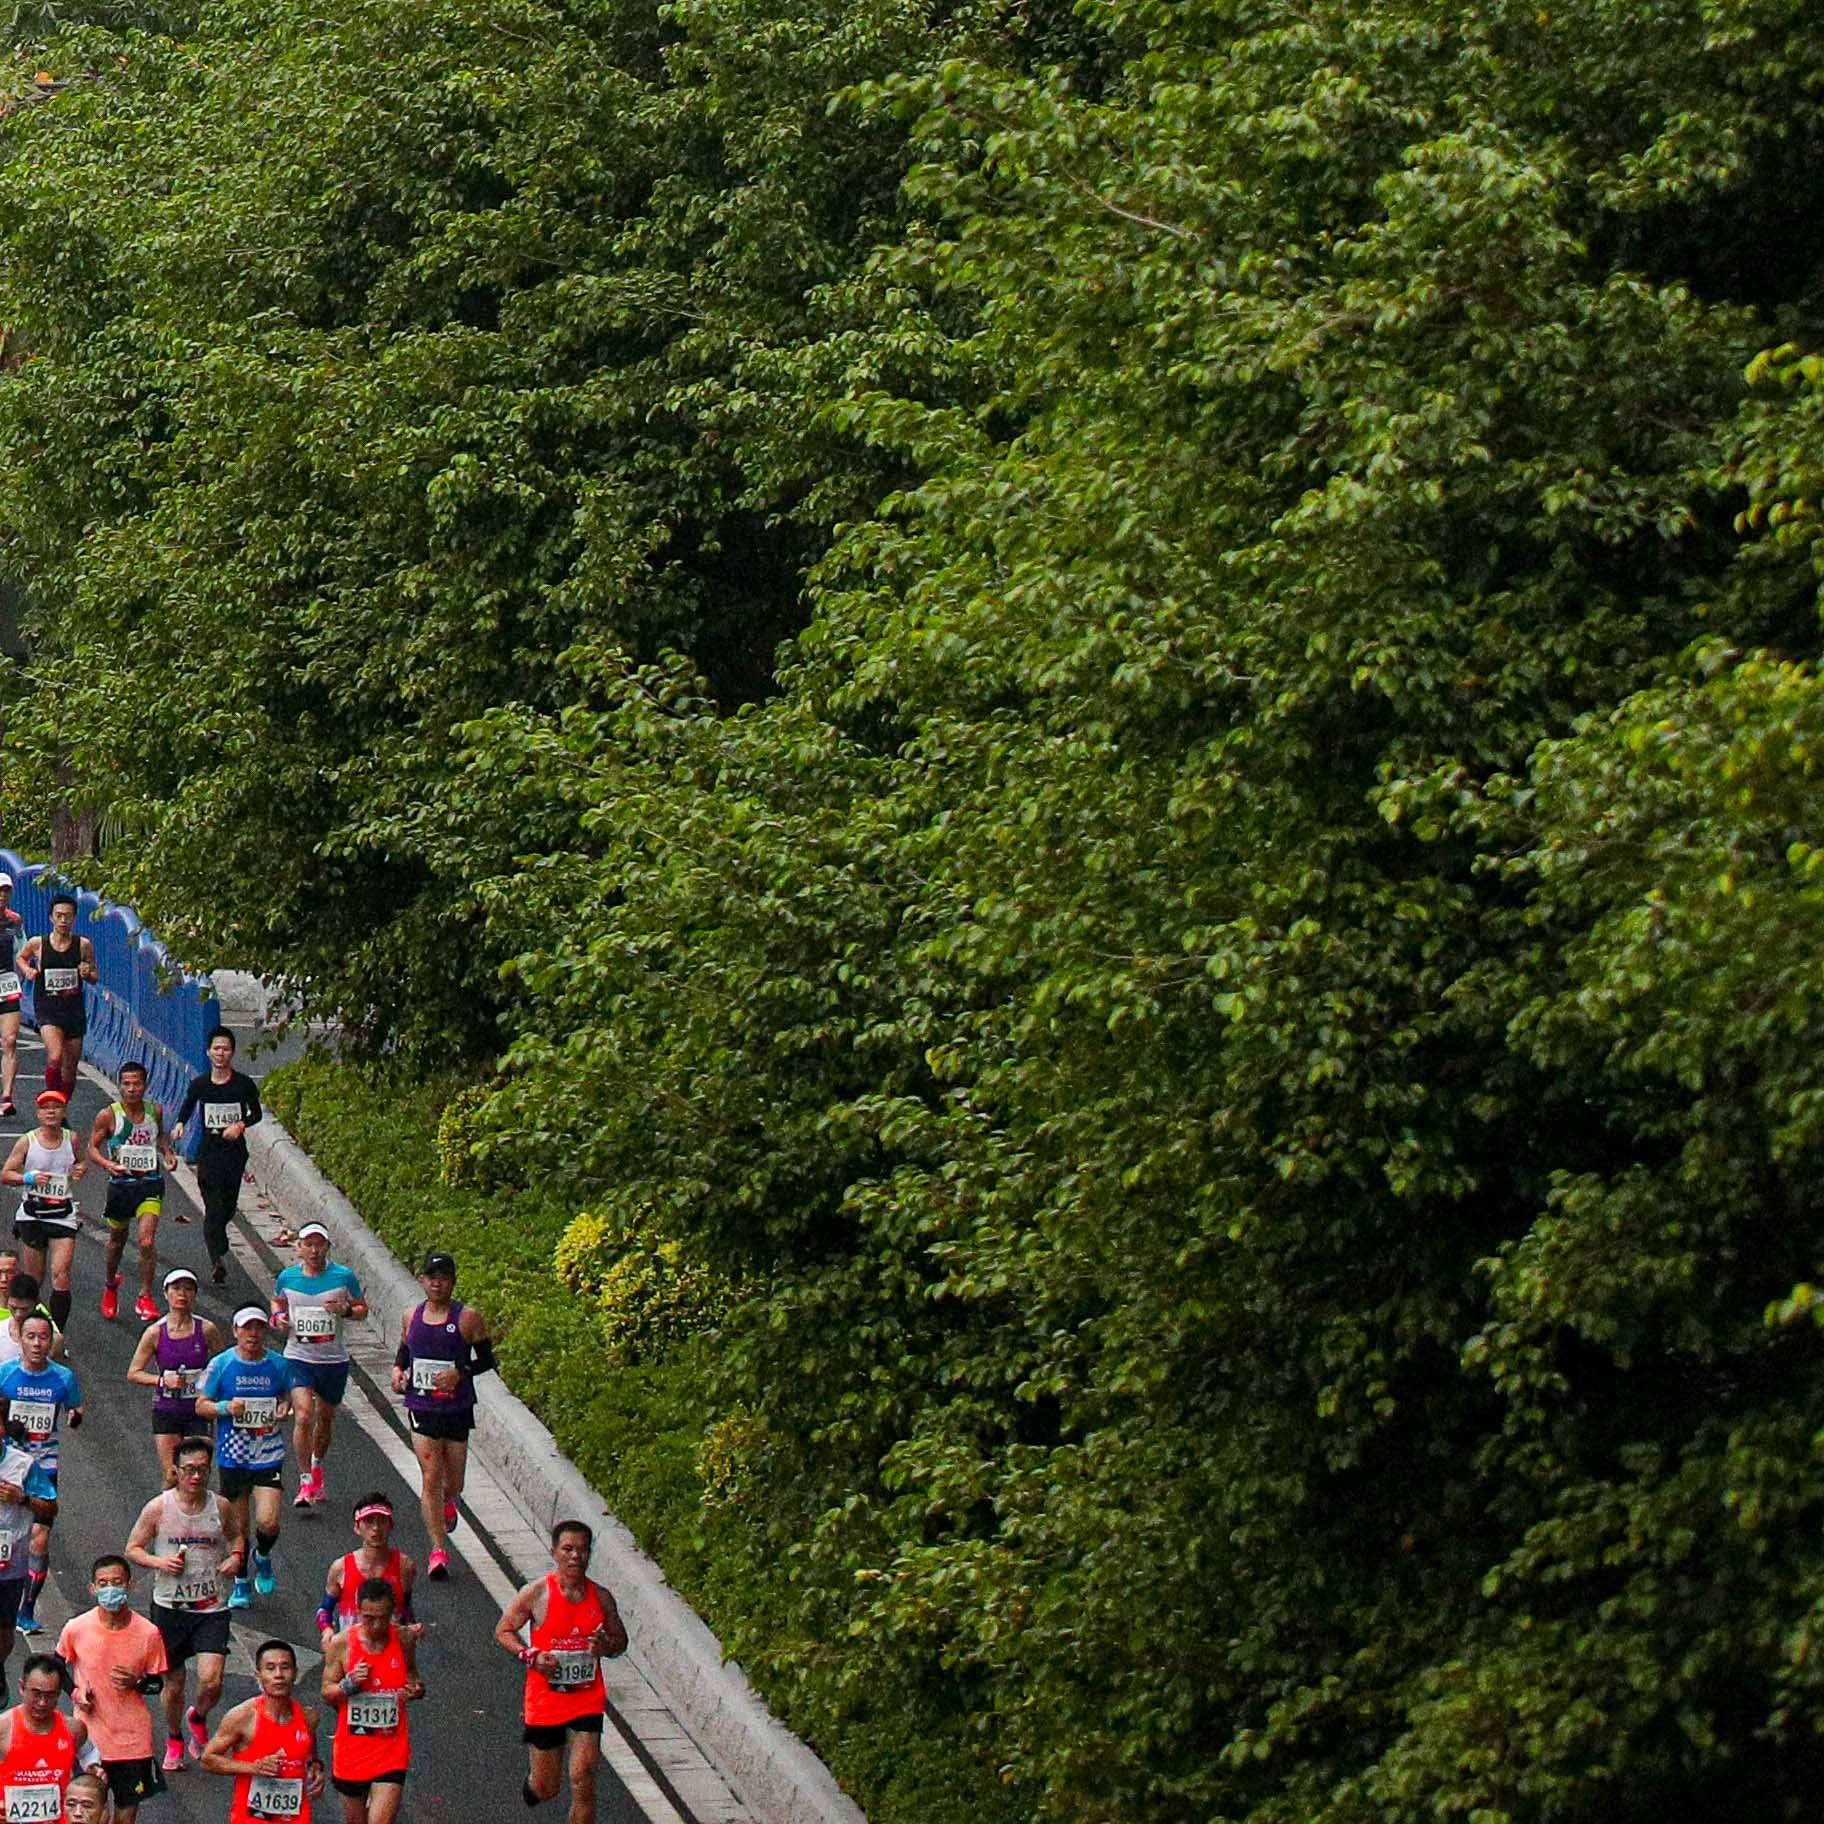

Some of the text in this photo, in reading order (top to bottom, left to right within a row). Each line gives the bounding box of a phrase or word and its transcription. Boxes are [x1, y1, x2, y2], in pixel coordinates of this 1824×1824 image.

[298, 1320, 333, 1333] B0671
[175, 1580, 215, 1598] A1783
[351, 1708, 397, 1724] B1312
[9, 1800, 58, 1818] A2214
[251, 1792, 298, 1810] A1639
